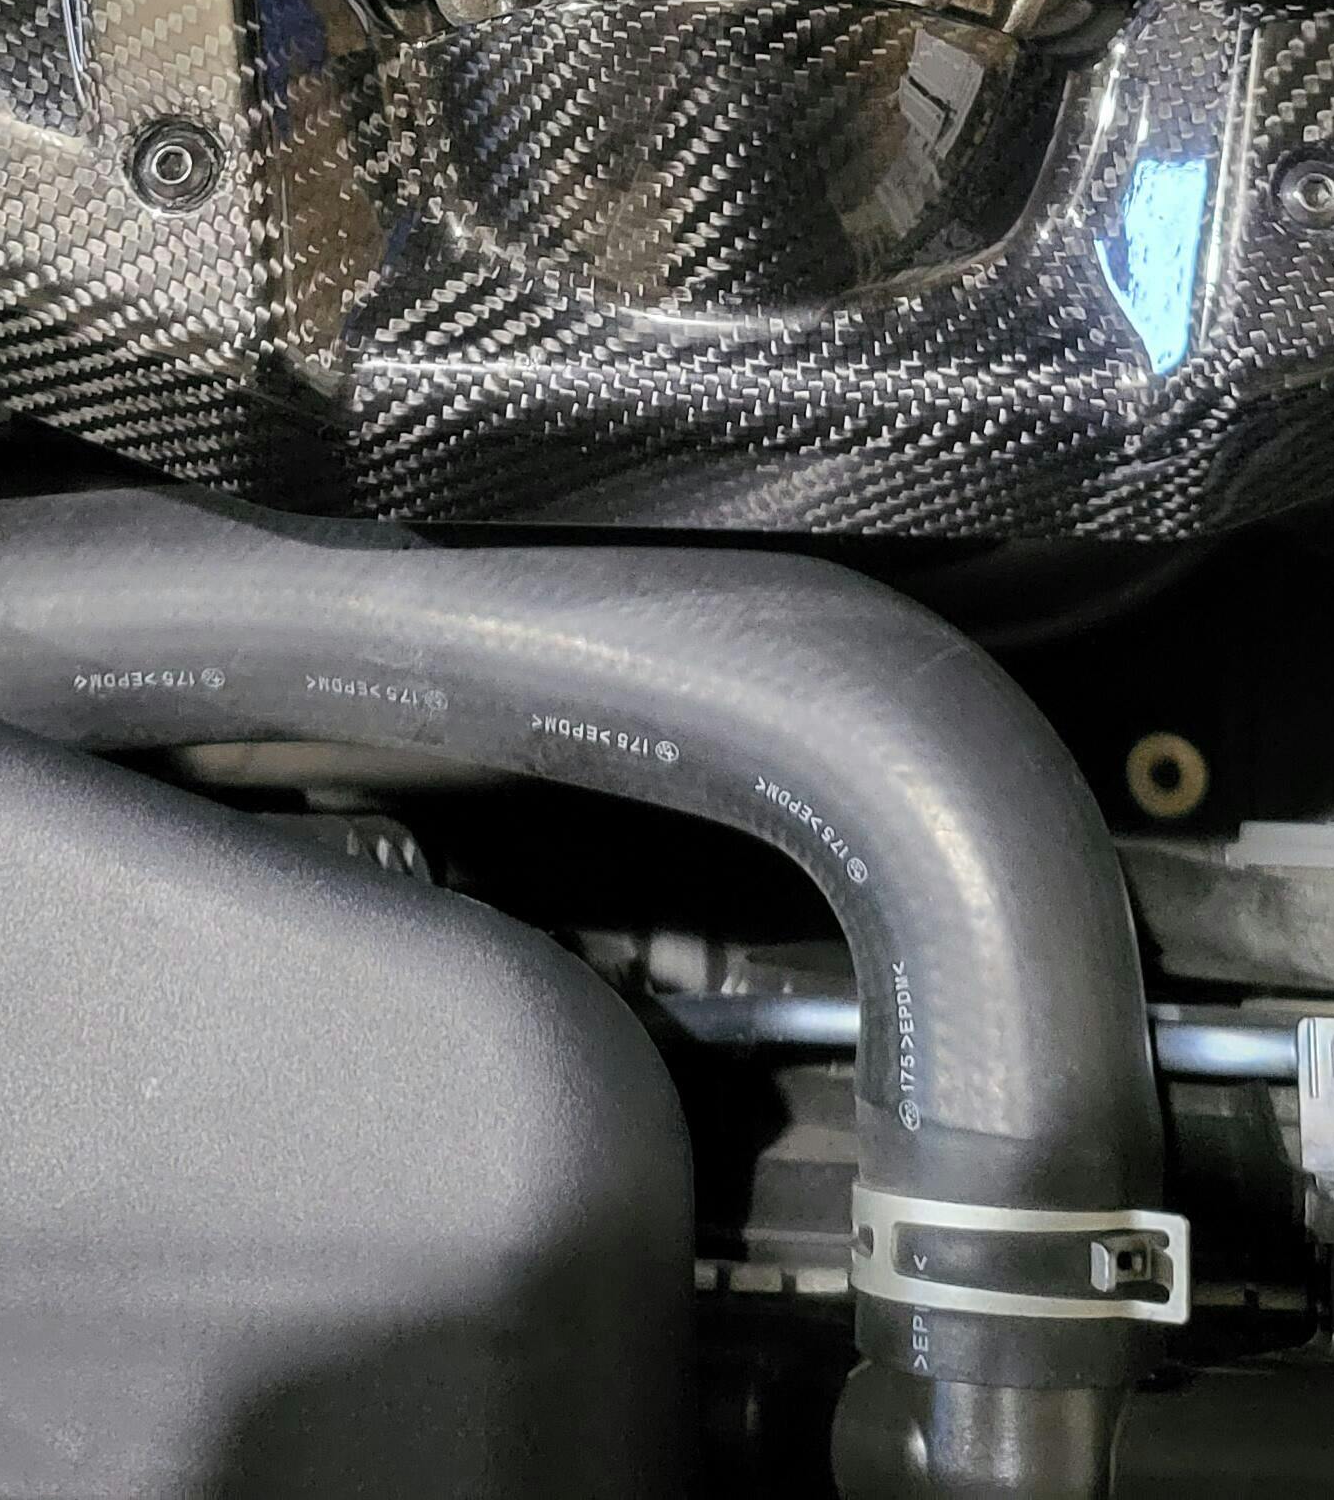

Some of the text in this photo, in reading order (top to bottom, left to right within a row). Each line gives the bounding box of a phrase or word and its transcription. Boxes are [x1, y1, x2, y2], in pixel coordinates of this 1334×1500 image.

[162, 670, 195, 688] 175
[385, 686, 418, 706] 175
[617, 732, 649, 755] 175
[821, 825, 849, 859] 175
[899, 1055, 916, 1093] 175
